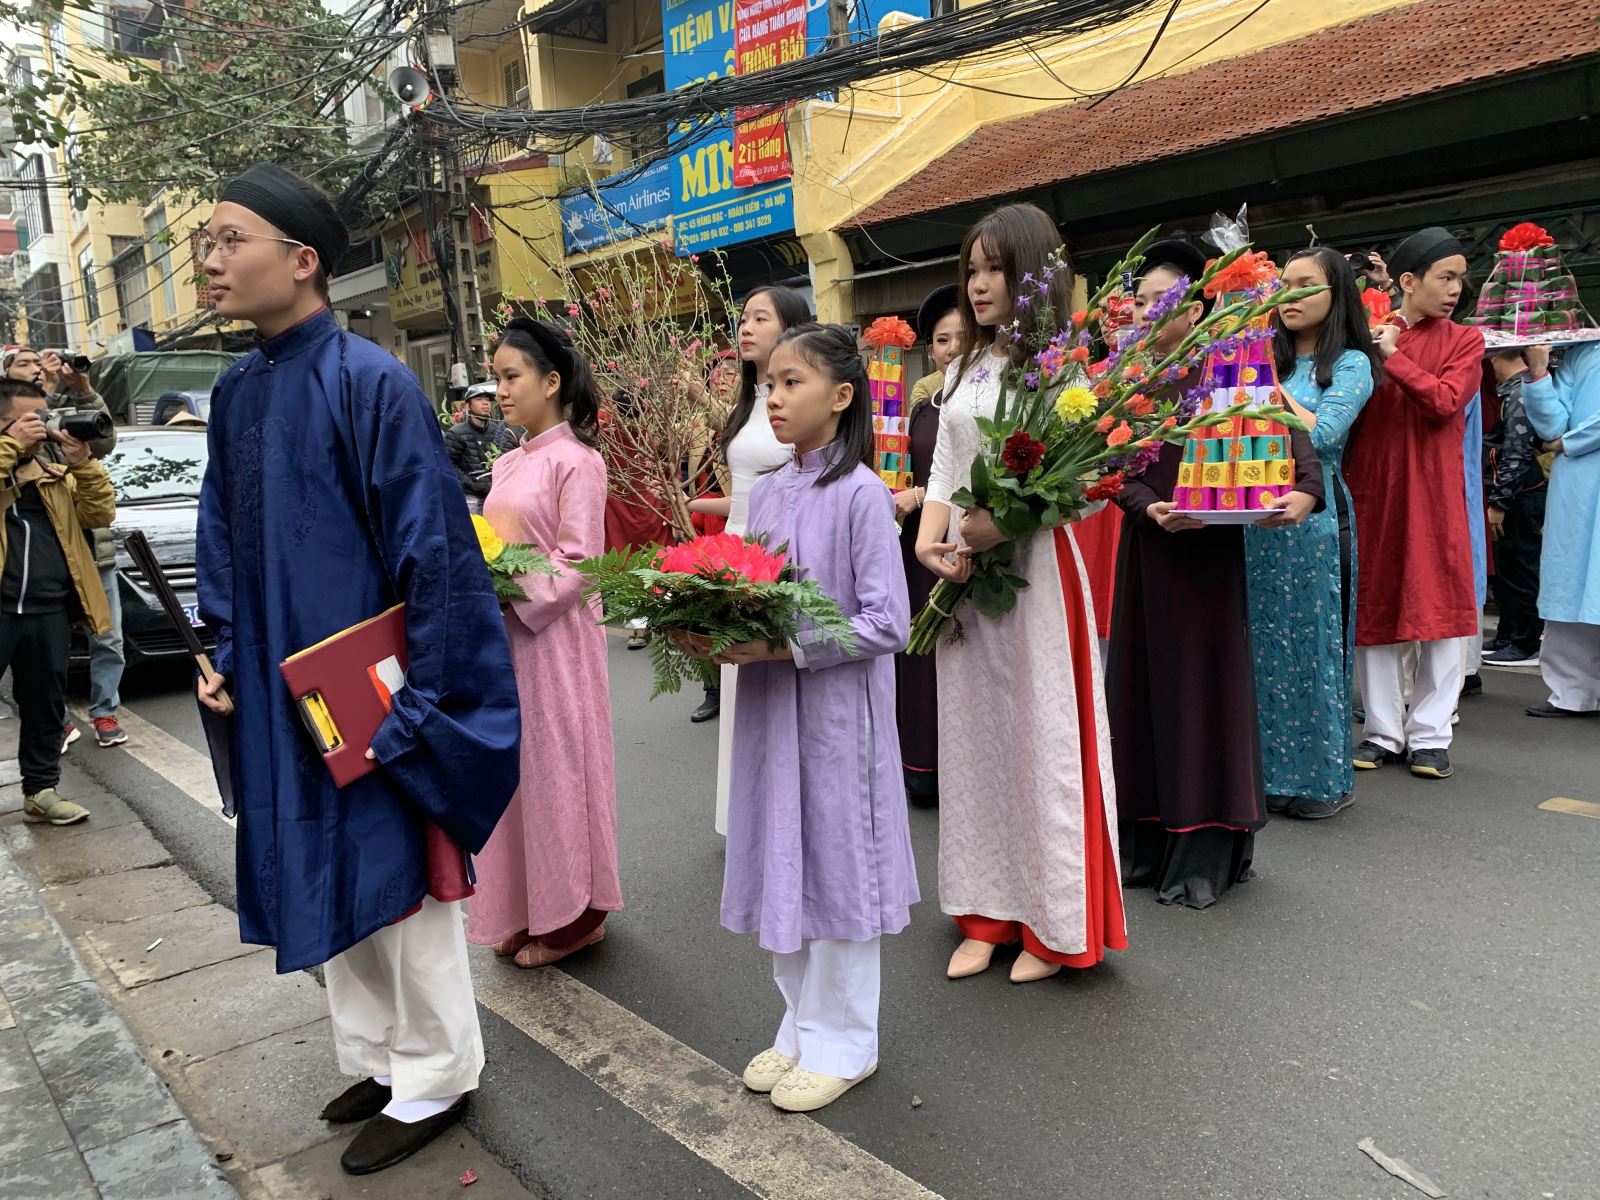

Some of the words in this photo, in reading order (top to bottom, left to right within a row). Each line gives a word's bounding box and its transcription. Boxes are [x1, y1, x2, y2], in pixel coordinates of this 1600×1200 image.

[669, 10, 713, 56] TIỆM
[717, 0, 735, 34] V
[740, 42, 776, 76] THÔNG
[780, 29, 805, 65] BÁO
[628, 187, 671, 213] Airlines
